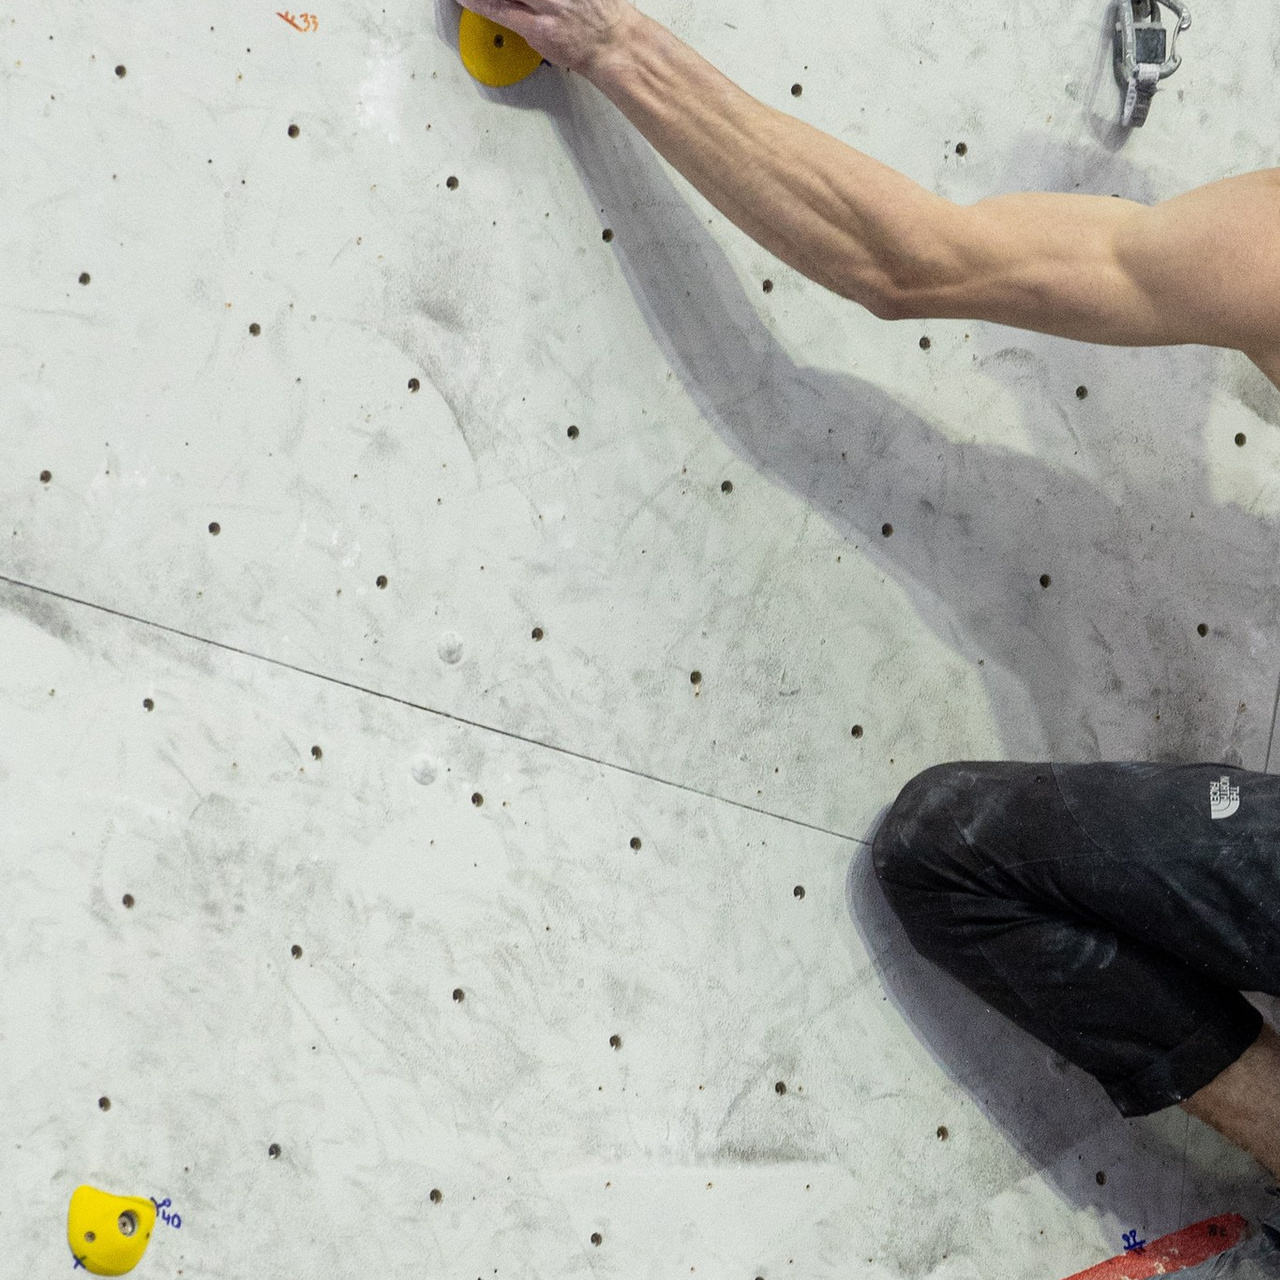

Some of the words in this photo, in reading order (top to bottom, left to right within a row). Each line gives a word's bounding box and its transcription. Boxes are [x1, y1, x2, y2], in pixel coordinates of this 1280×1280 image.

[299, 12, 319, 33] 33
[1209, 781, 1220, 803] FACE
[1229, 785, 1240, 802] THE
[161, 1208, 182, 1229] 40
